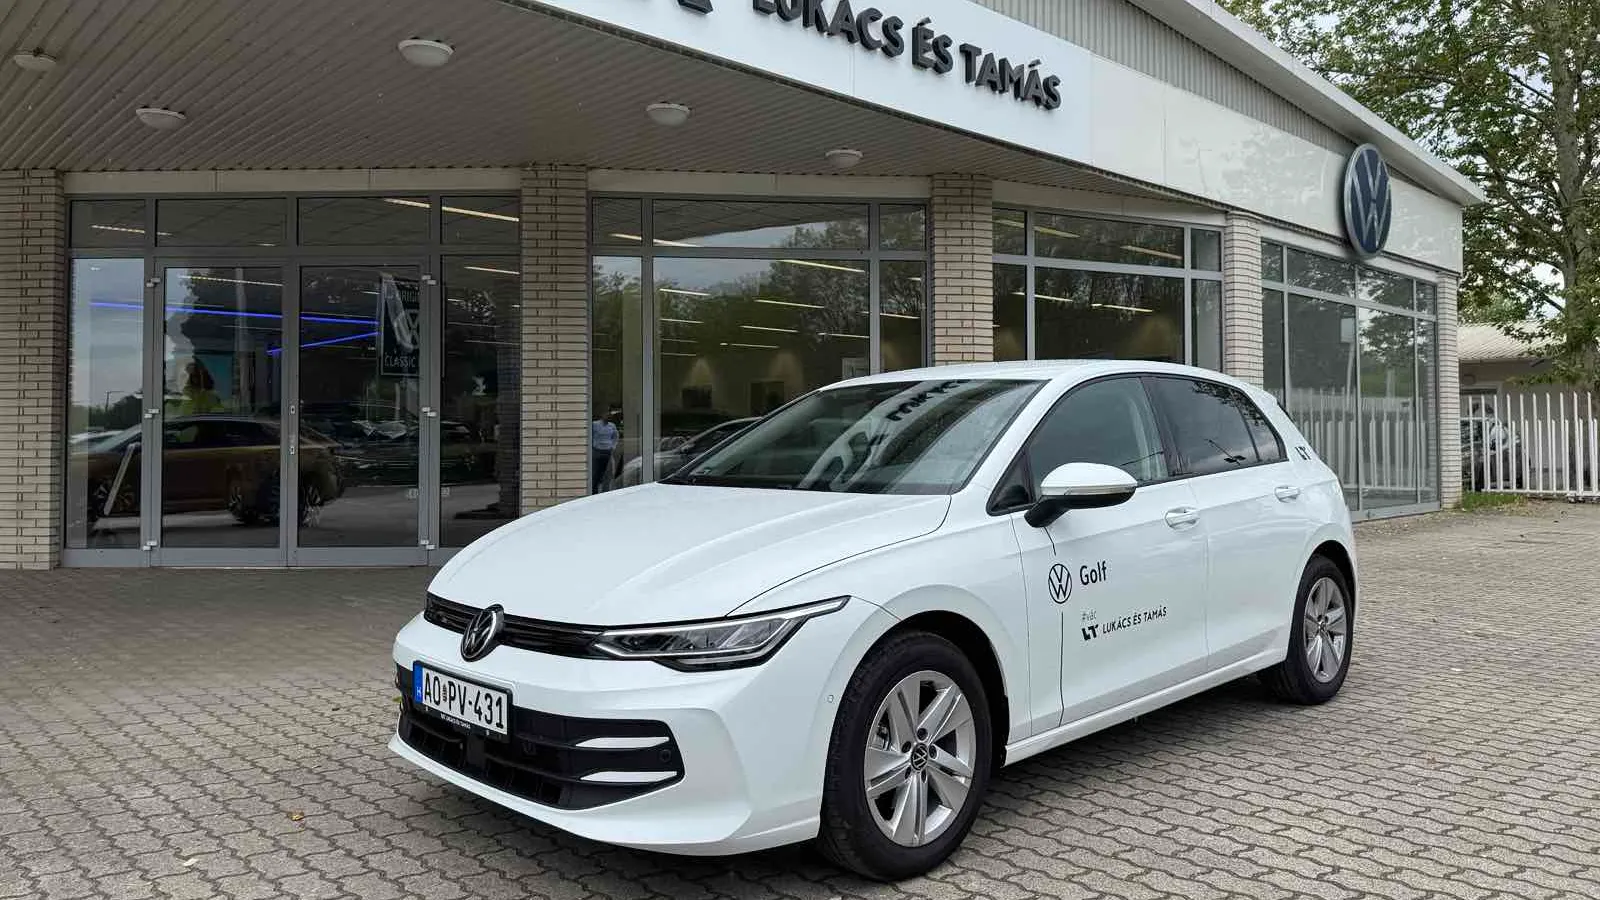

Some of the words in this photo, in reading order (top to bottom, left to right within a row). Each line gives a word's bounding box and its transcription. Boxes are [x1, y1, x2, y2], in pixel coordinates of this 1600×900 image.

[911, 17, 954, 75] ÉS
[959, 43, 1062, 111] TAMÁS
[384, 355, 417, 368] CLASSIC
[1080, 560, 1107, 586] Golf
[1102, 615, 1132, 634] LUKÁCS
[1132, 611, 1142, 625] ÉS
[1143, 604, 1168, 622] TAMÁS
